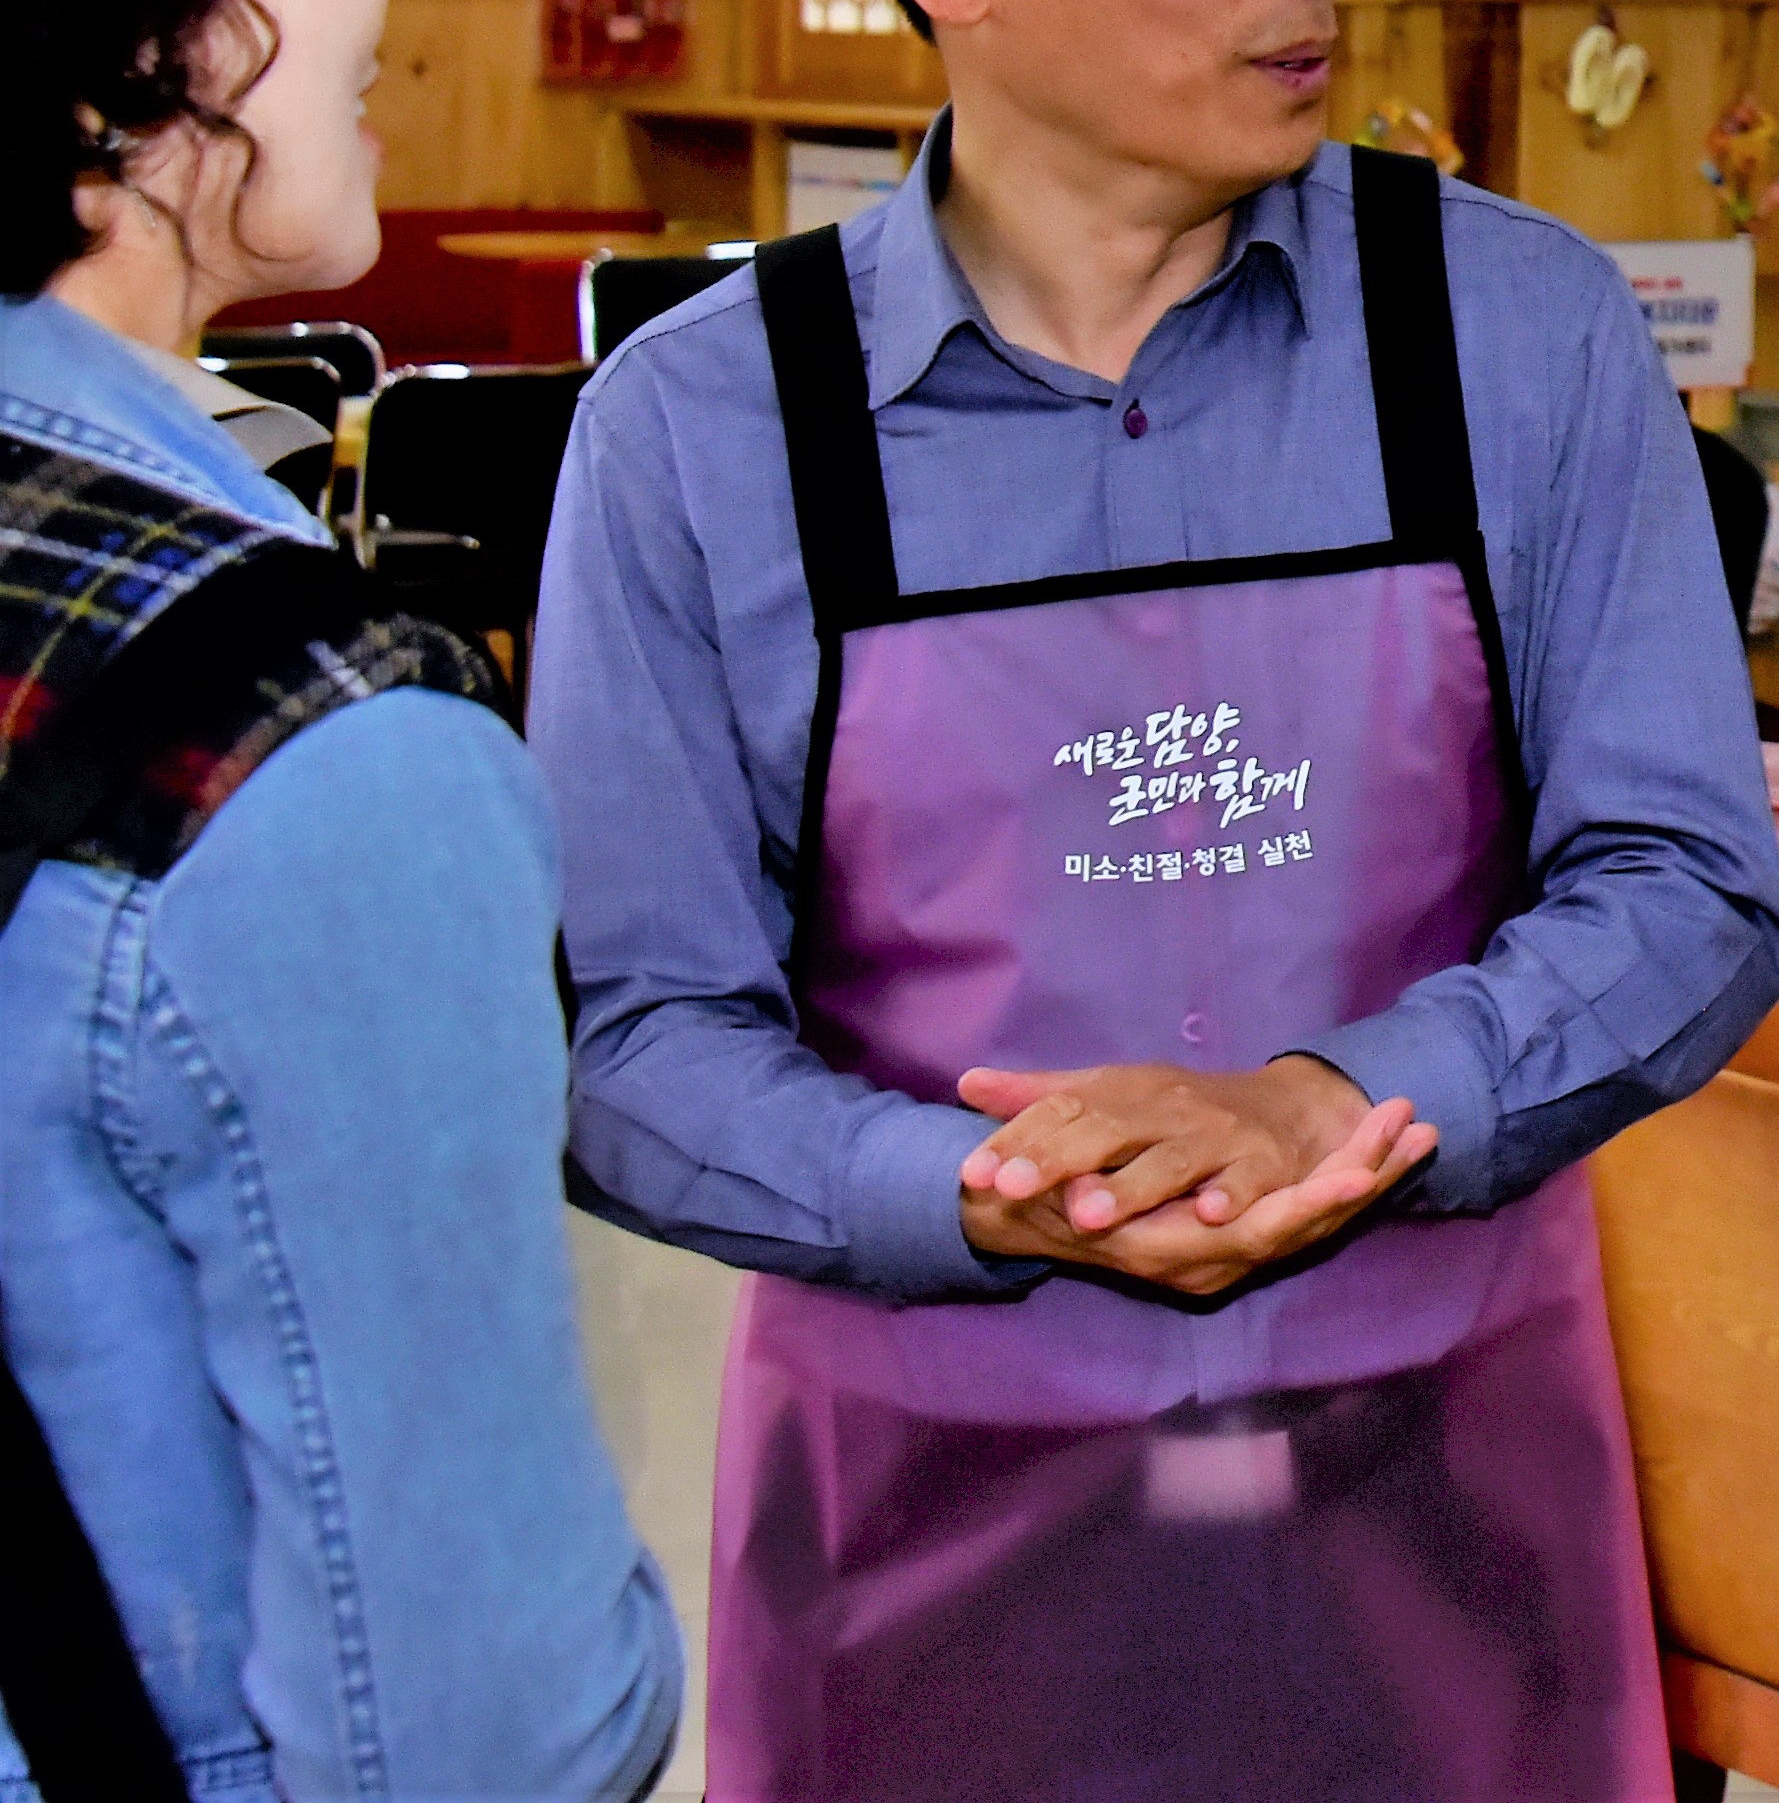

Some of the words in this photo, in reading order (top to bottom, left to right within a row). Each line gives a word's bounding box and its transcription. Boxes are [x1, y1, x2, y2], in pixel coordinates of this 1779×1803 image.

[1053, 726, 1146, 777] 새로운
[1108, 771, 1206, 827] 군민과
[1208, 757, 1311, 829] 함께
[1257, 829, 1314, 868] 실천
